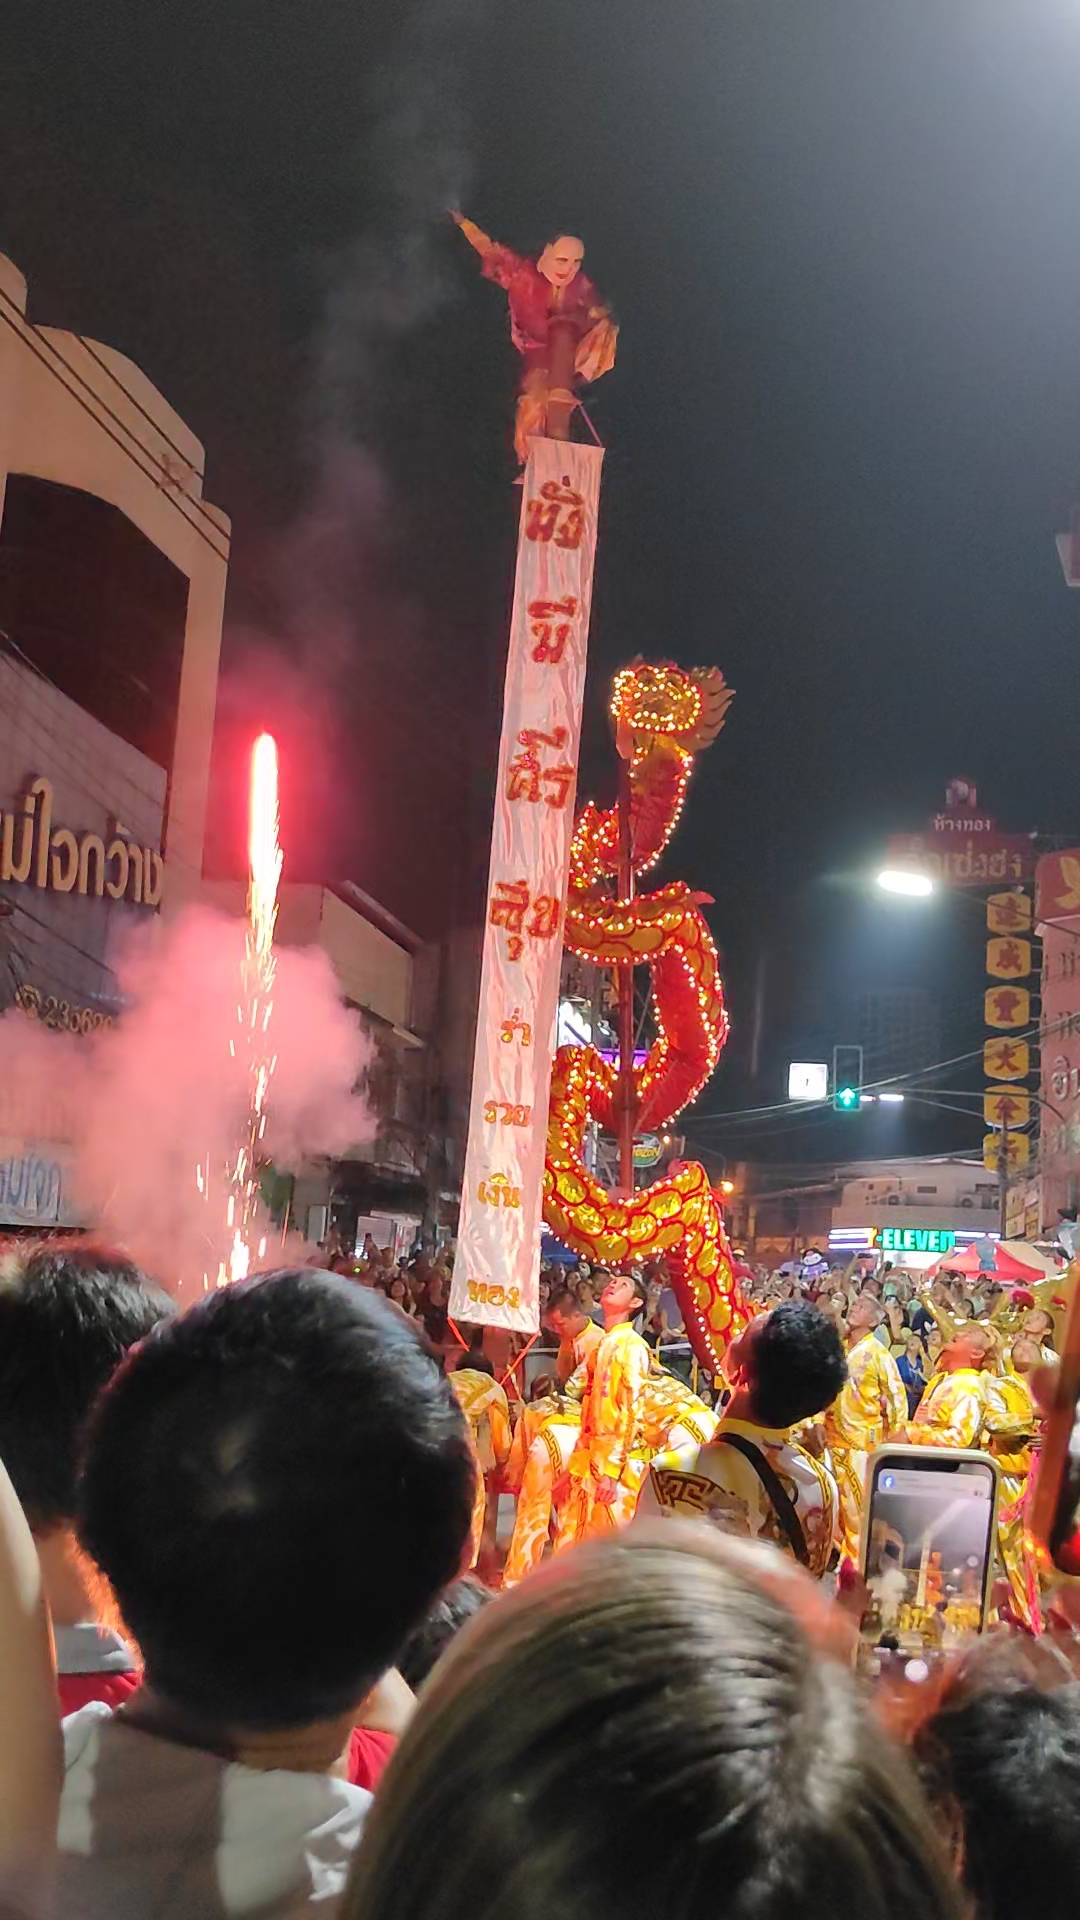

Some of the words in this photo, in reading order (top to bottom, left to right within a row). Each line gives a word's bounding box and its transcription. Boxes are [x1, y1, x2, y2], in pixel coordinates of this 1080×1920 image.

[526, 475, 584, 549] มั่ง
[529, 596, 577, 664] มี
[934, 814, 991, 832] ห้างทอง
[483, 1101, 531, 1127] รวย
[478, 1173, 520, 1208] เงิน
[467, 1280, 520, 1308] ทอง
